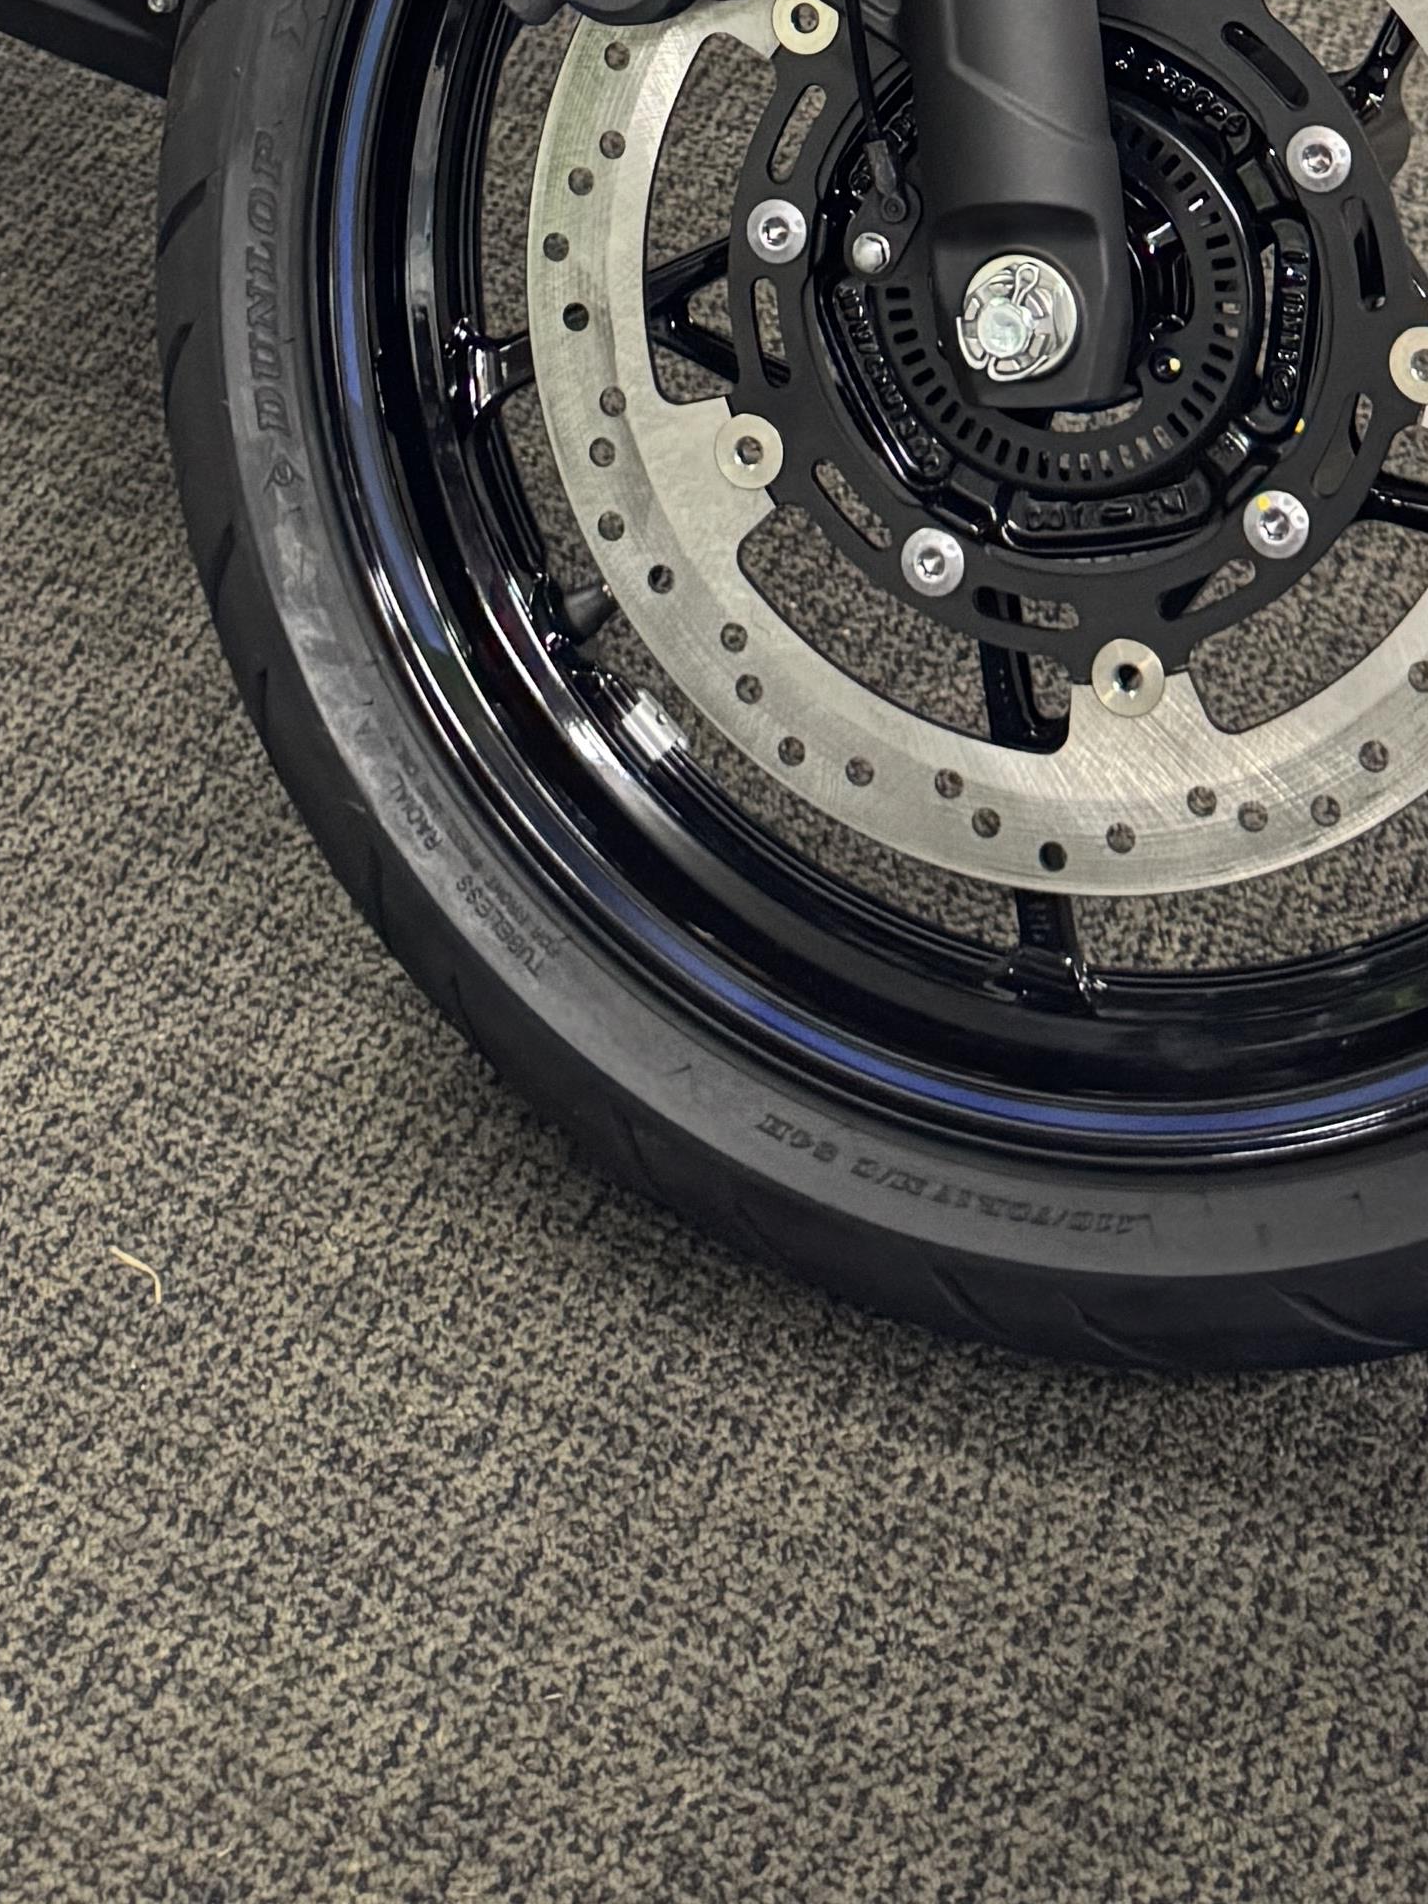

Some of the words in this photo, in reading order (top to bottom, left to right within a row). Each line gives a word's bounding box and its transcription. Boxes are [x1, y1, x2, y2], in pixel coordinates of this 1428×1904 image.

[245, 128, 289, 437] DUNLOP
[388, 770, 445, 854] RADIAL
[456, 873, 545, 979] TUBELESS
